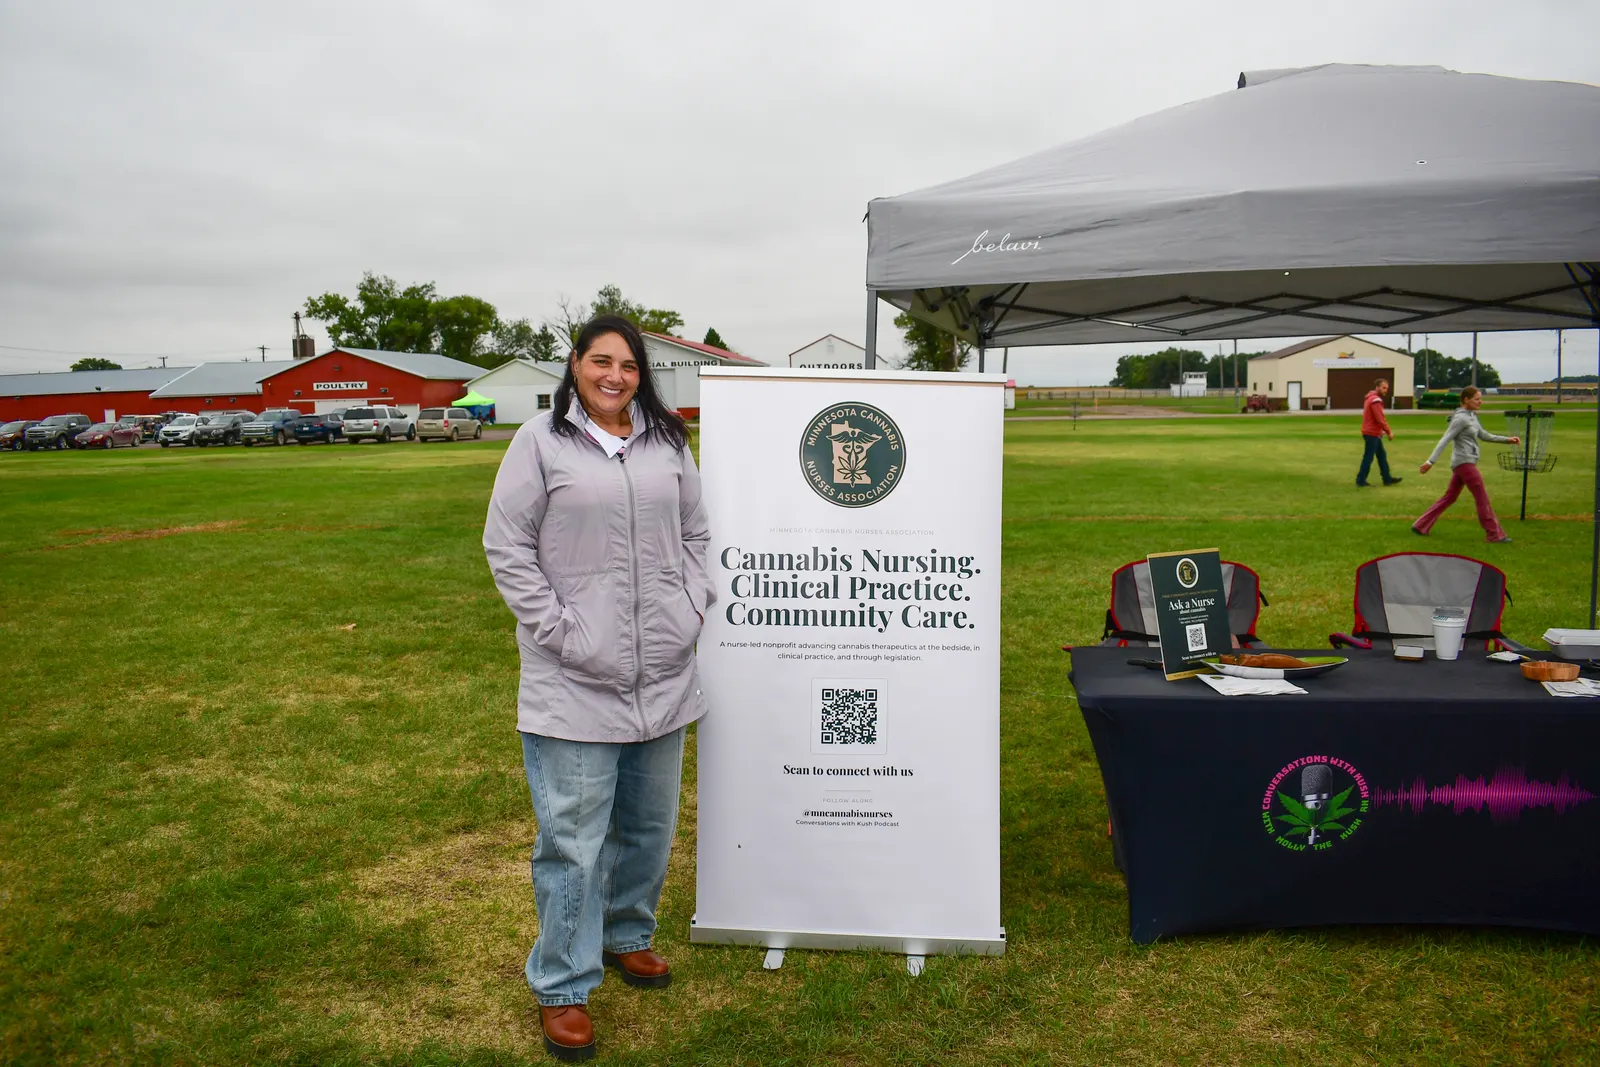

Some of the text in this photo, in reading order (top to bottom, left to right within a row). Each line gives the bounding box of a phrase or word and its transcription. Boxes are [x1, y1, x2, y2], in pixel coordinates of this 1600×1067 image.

[951, 230, 1042, 265] belavi
[316, 382, 364, 390] POULTRY
[807, 408, 899, 451] MINNESOTA CANNABIS
[807, 460, 899, 502] NURSES ASSOCIATION
[720, 546, 981, 579] Cannabis Nursing.
[731, 573, 970, 601] Clinical Practice.
[726, 601, 975, 633] Community Care.
[1168, 597, 1216, 611] Ask a Nurse
[763, 641, 797, 649] nonprofit
[798, 642, 836, 650] advancing
[871, 643, 918, 651] therapeutics
[941, 644, 973, 652] bedside,
[804, 653, 836, 661] practice,
[853, 654, 882, 662] through
[883, 654, 923, 662] legislation.
[783, 764, 914, 777] Scan to connect with us
[1262, 755, 1369, 810] CONVERSATIONS WITH KUSH
[803, 809, 893, 818] @mncannabisnurses
[1262, 800, 1369, 851] WITH MOLLY THE KUSH RN
